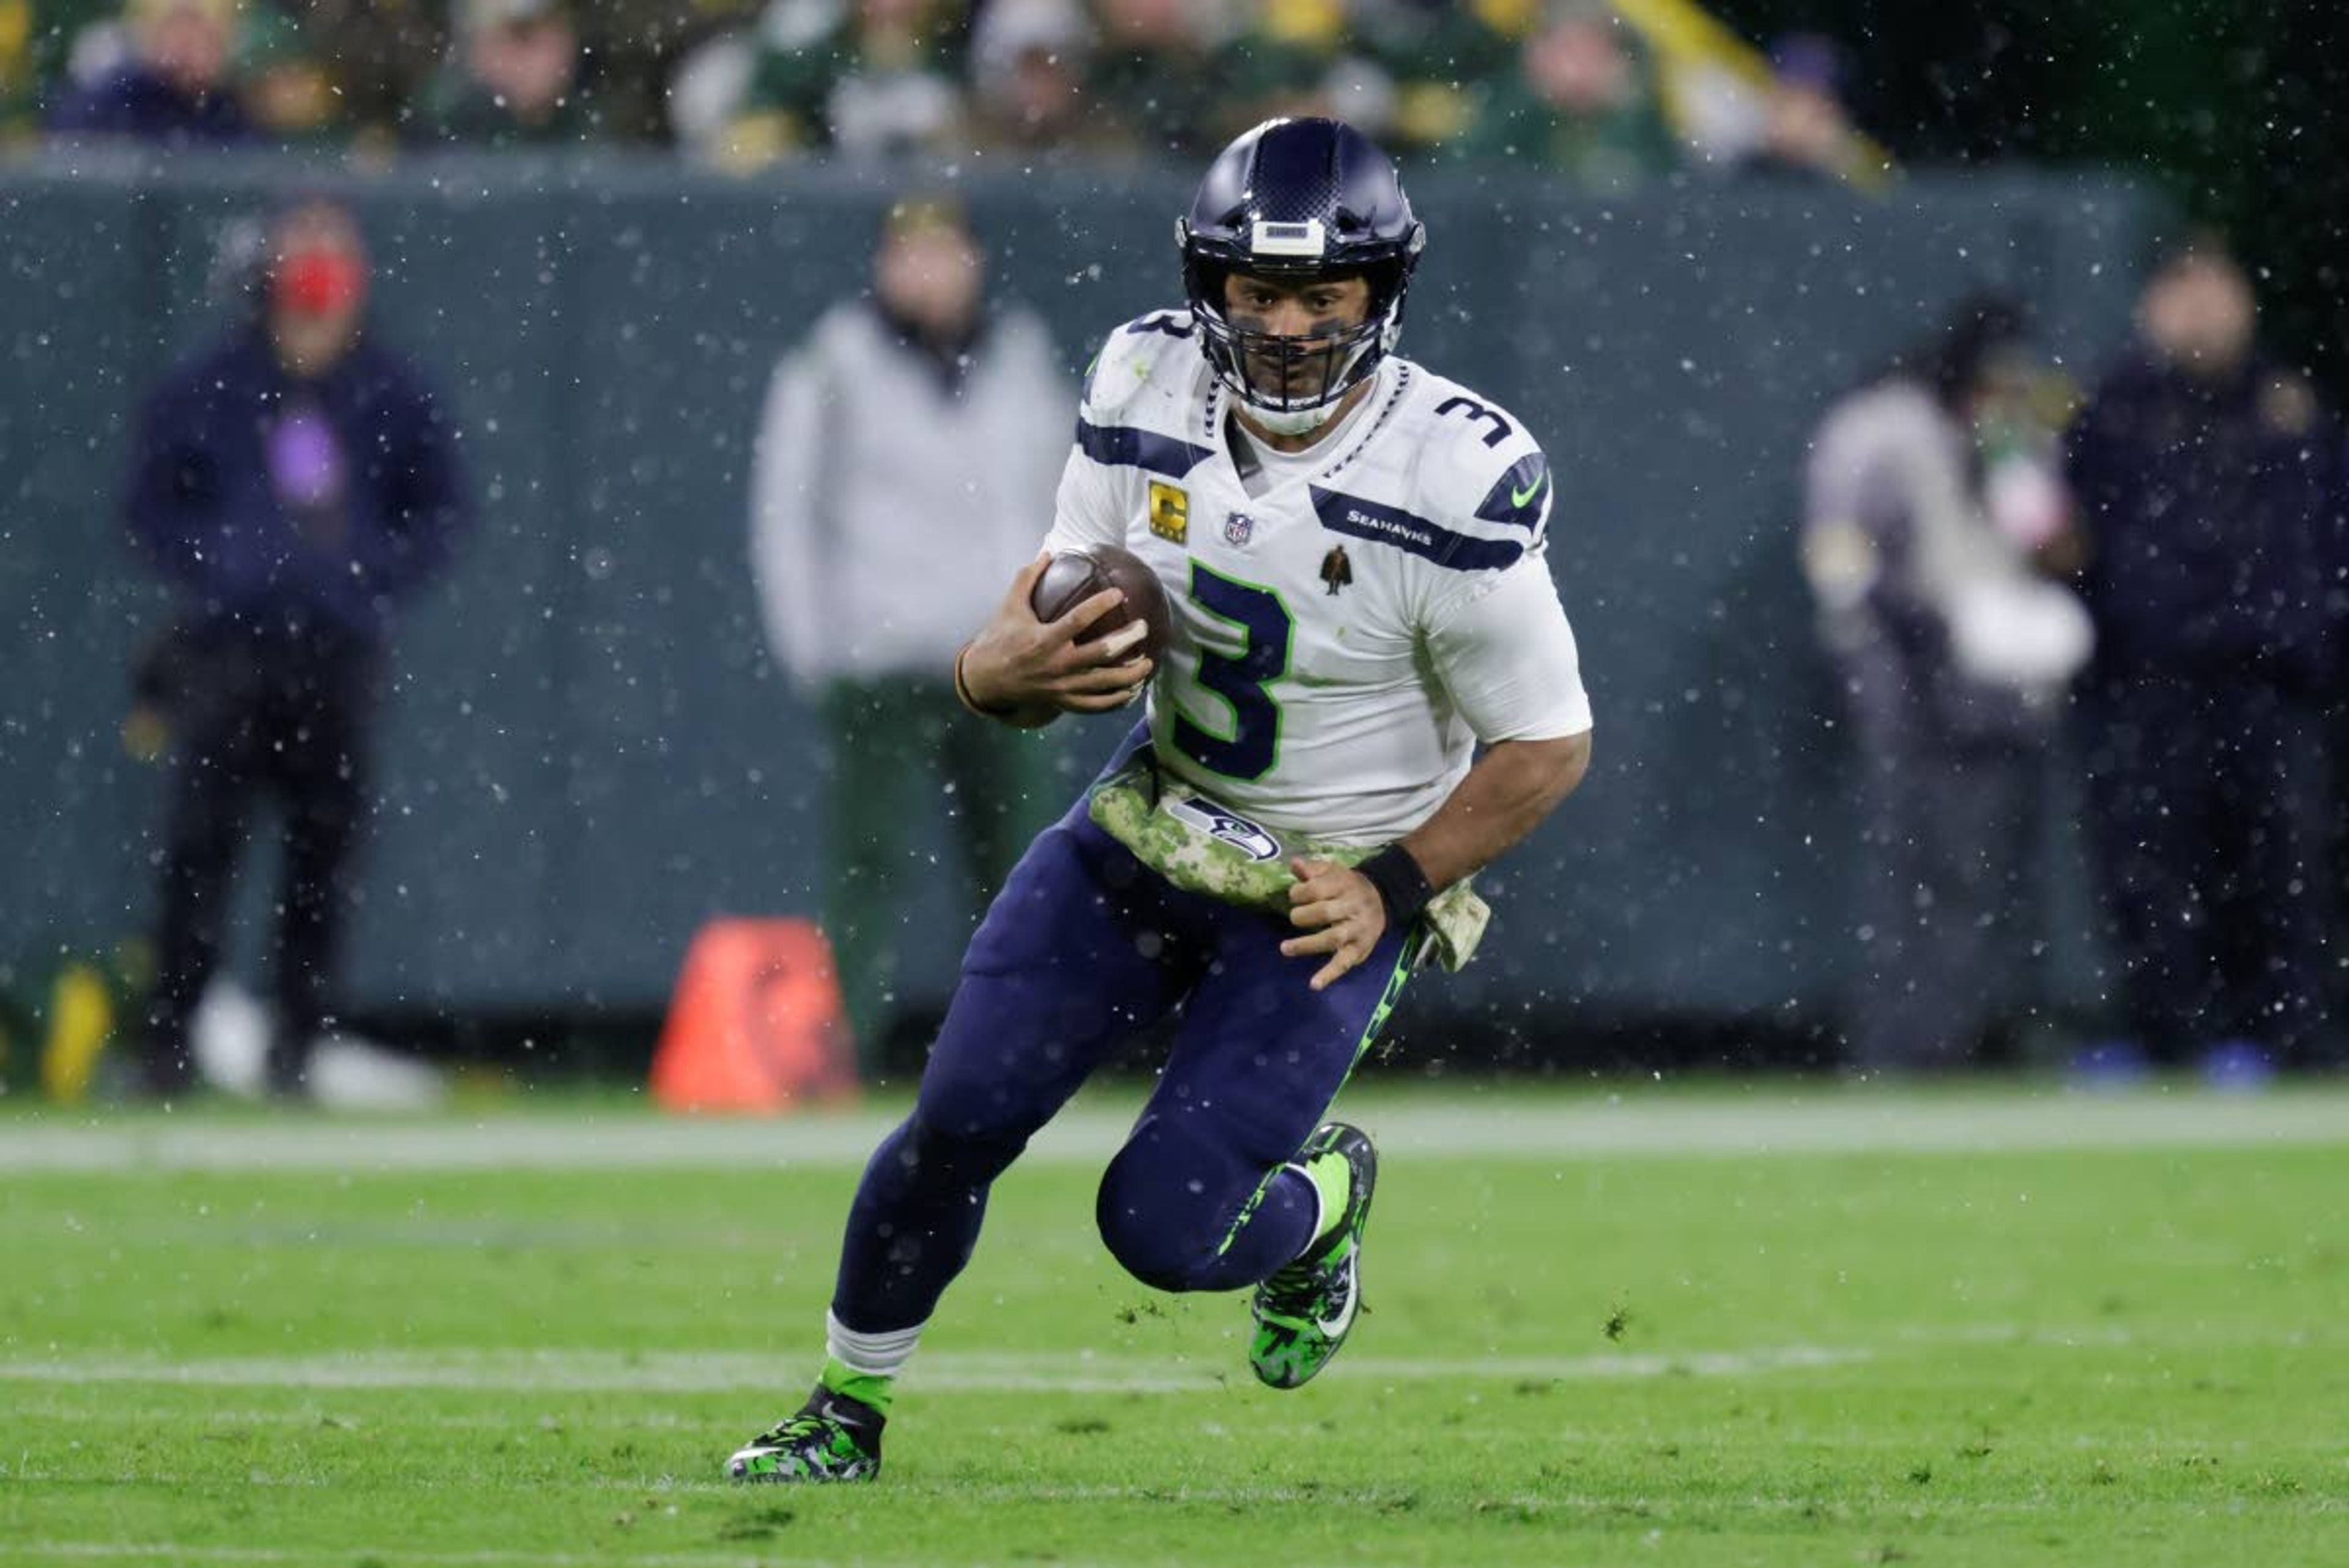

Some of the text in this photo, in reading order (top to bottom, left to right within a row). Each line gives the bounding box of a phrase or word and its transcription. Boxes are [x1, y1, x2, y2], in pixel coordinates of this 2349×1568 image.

[1434, 396, 1512, 448] 3
[1151, 485, 1186, 530] C
[1171, 555, 1297, 784] 3
